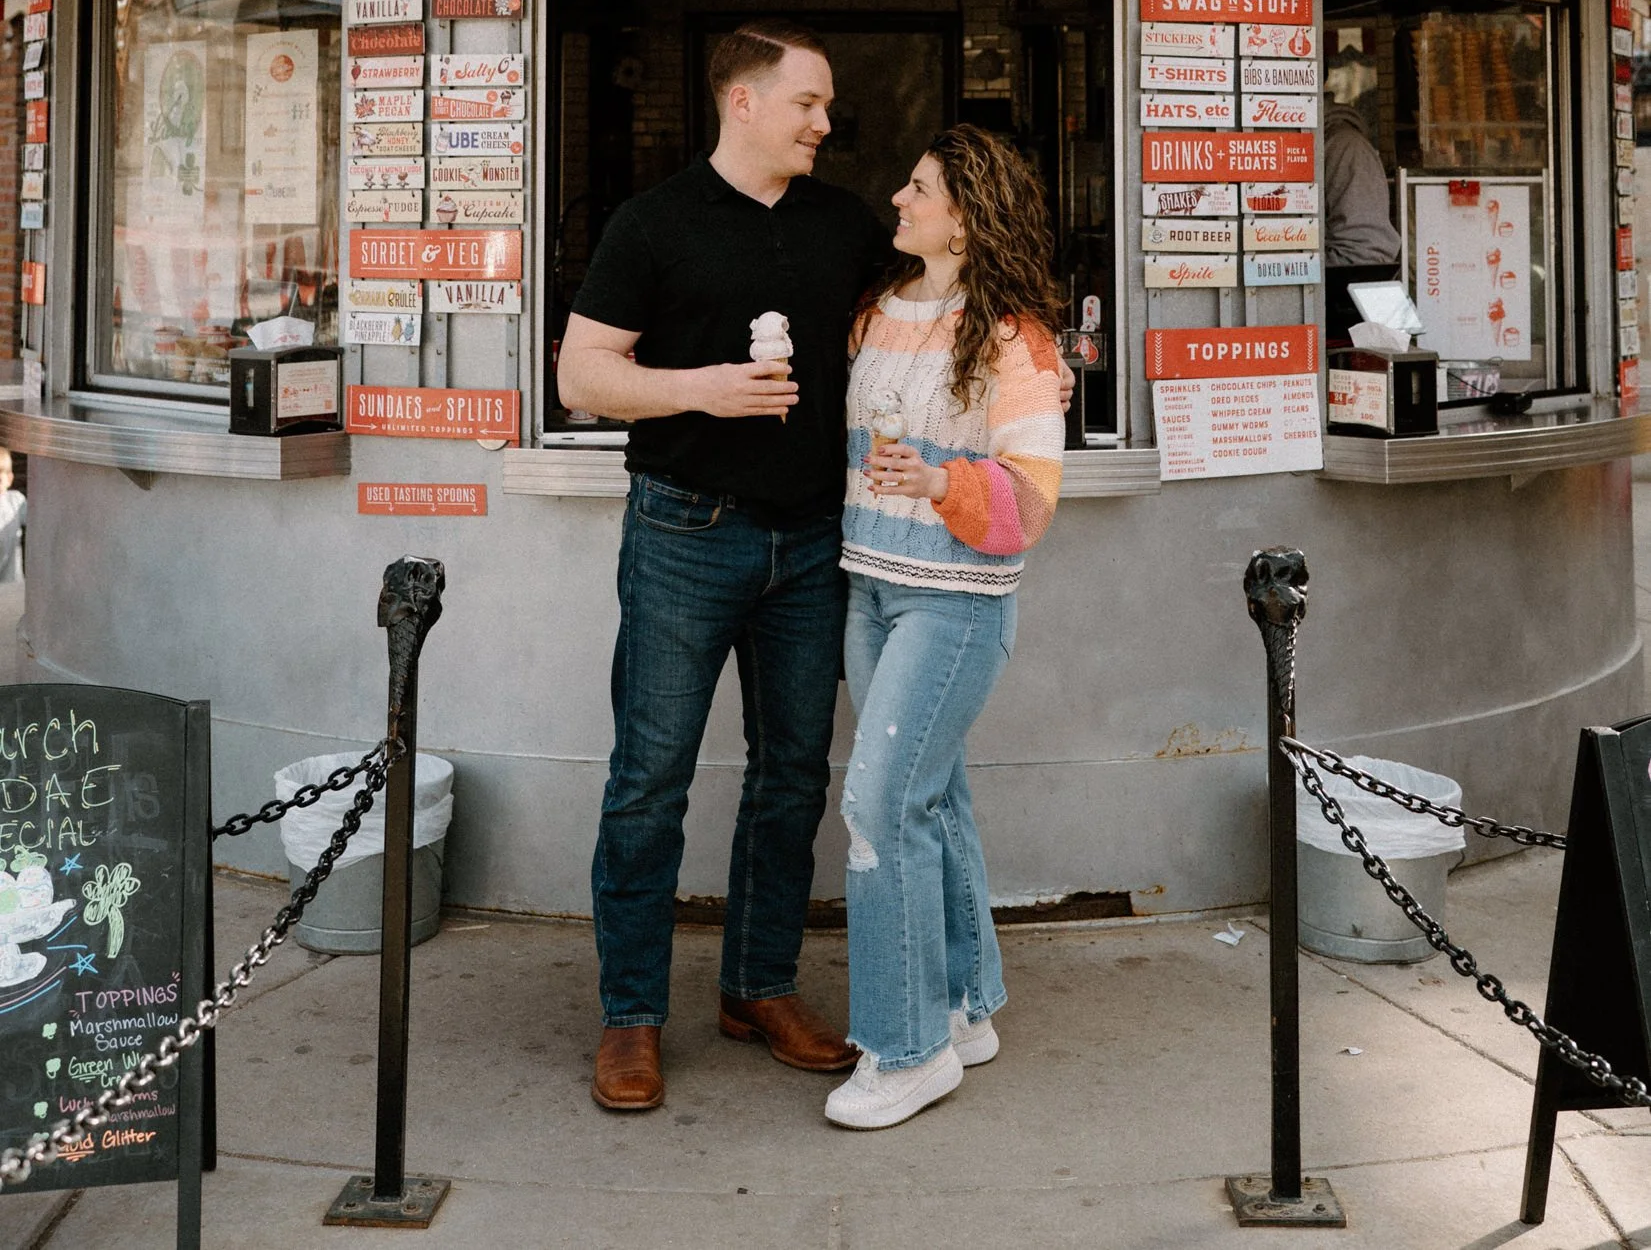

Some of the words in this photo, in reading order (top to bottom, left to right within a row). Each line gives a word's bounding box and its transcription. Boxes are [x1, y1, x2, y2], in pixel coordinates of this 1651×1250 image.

[355, 0, 400, 19] VANILLA
[350, 29, 422, 51] Chocolate
[1145, 32, 1203, 45] STICKERS
[361, 67, 420, 79] STRAWBERRY
[455, 61, 497, 83] Salty
[1148, 66, 1227, 82] T-SHIRTS
[1244, 68, 1262, 86] BIBS
[1264, 71, 1271, 84] &
[1272, 68, 1315, 87] BANDANAS
[378, 95, 412, 106] MAPLE
[378, 106, 412, 117] PECAN
[450, 100, 490, 118] CHOCOLATE
[1146, 104, 1202, 120] HATS,
[1205, 104, 1230, 116] etc
[1252, 99, 1306, 123] Fleece
[449, 131, 480, 148] UBE
[480, 131, 510, 140] CREAM
[480, 140, 512, 149] CHEESE
[1228, 140, 1277, 155] SHAKES
[1151, 140, 1213, 171] DRINKS
[1228, 156, 1277, 171] FLOATS
[1286, 155, 1308, 163] FLAVOR
[432, 167, 462, 182] COOKIE
[482, 166, 520, 182] MONSTER
[1160, 191, 1197, 211] SHAKES
[1252, 197, 1281, 211] FLOATS
[347, 201, 385, 218] Espresso
[387, 202, 419, 212] FUDGE
[463, 204, 516, 221] Cupcake
[1169, 230, 1199, 242] ROOT
[1202, 231, 1231, 242] BEER
[1255, 226, 1308, 242] Coca-Cola
[361, 241, 415, 266] SORBET
[421, 244, 442, 264] &
[446, 241, 506, 266] VEGAN
[1168, 262, 1215, 286] Sprite
[1257, 262, 1282, 278] BOXED
[1284, 261, 1309, 277] WATER
[1427, 246, 1441, 297] SCOOP
[445, 284, 506, 306] VANILLA
[349, 319, 388, 331] BLACKBERRY
[354, 330, 386, 342] PINEAPPLE
[1186, 341, 1291, 361] TOPPINGS
[1160, 384, 1201, 394] SPRINKLES
[1210, 382, 1254, 391] CHOCOLATE
[1256, 380, 1277, 388] CHIPS
[1283, 378, 1312, 387] PEANUTS
[1210, 396, 1231, 405] OREO
[1233, 394, 1260, 403] PIECES
[1283, 391, 1314, 401] ALMONDS
[359, 393, 423, 420] SUNDAES
[426, 403, 442, 414] and
[446, 397, 504, 422] SPLITS
[1211, 409, 1246, 418] WHIPPED
[1248, 408, 1272, 416] CREAM
[1283, 405, 1309, 413] PECANS
[1161, 415, 1191, 424] SAUCES
[1211, 423, 1239, 432] GUMMY
[1241, 421, 1269, 429] WORMS
[381, 424, 426, 432] UNLIMITED
[430, 426, 473, 434] TOPPINGS
[1283, 430, 1318, 440] CHERRIES
[1212, 434, 1273, 445] MARSHMALLOWS
[1212, 448, 1240, 458] COOKIE
[1242, 447, 1267, 456] DOUGH
[366, 487, 390, 501] USED
[394, 487, 433, 502] TASTING
[437, 488, 476, 503] SPOONS
[75, 983, 178, 1013] TOPPINGS
[69, 1013, 179, 1037] Marshmallow
[94, 1033, 144, 1051] Sauce
[68, 1056, 113, 1076] Green
[100, 1072, 122, 1088] Cre
[102, 1128, 157, 1150] Glitter
